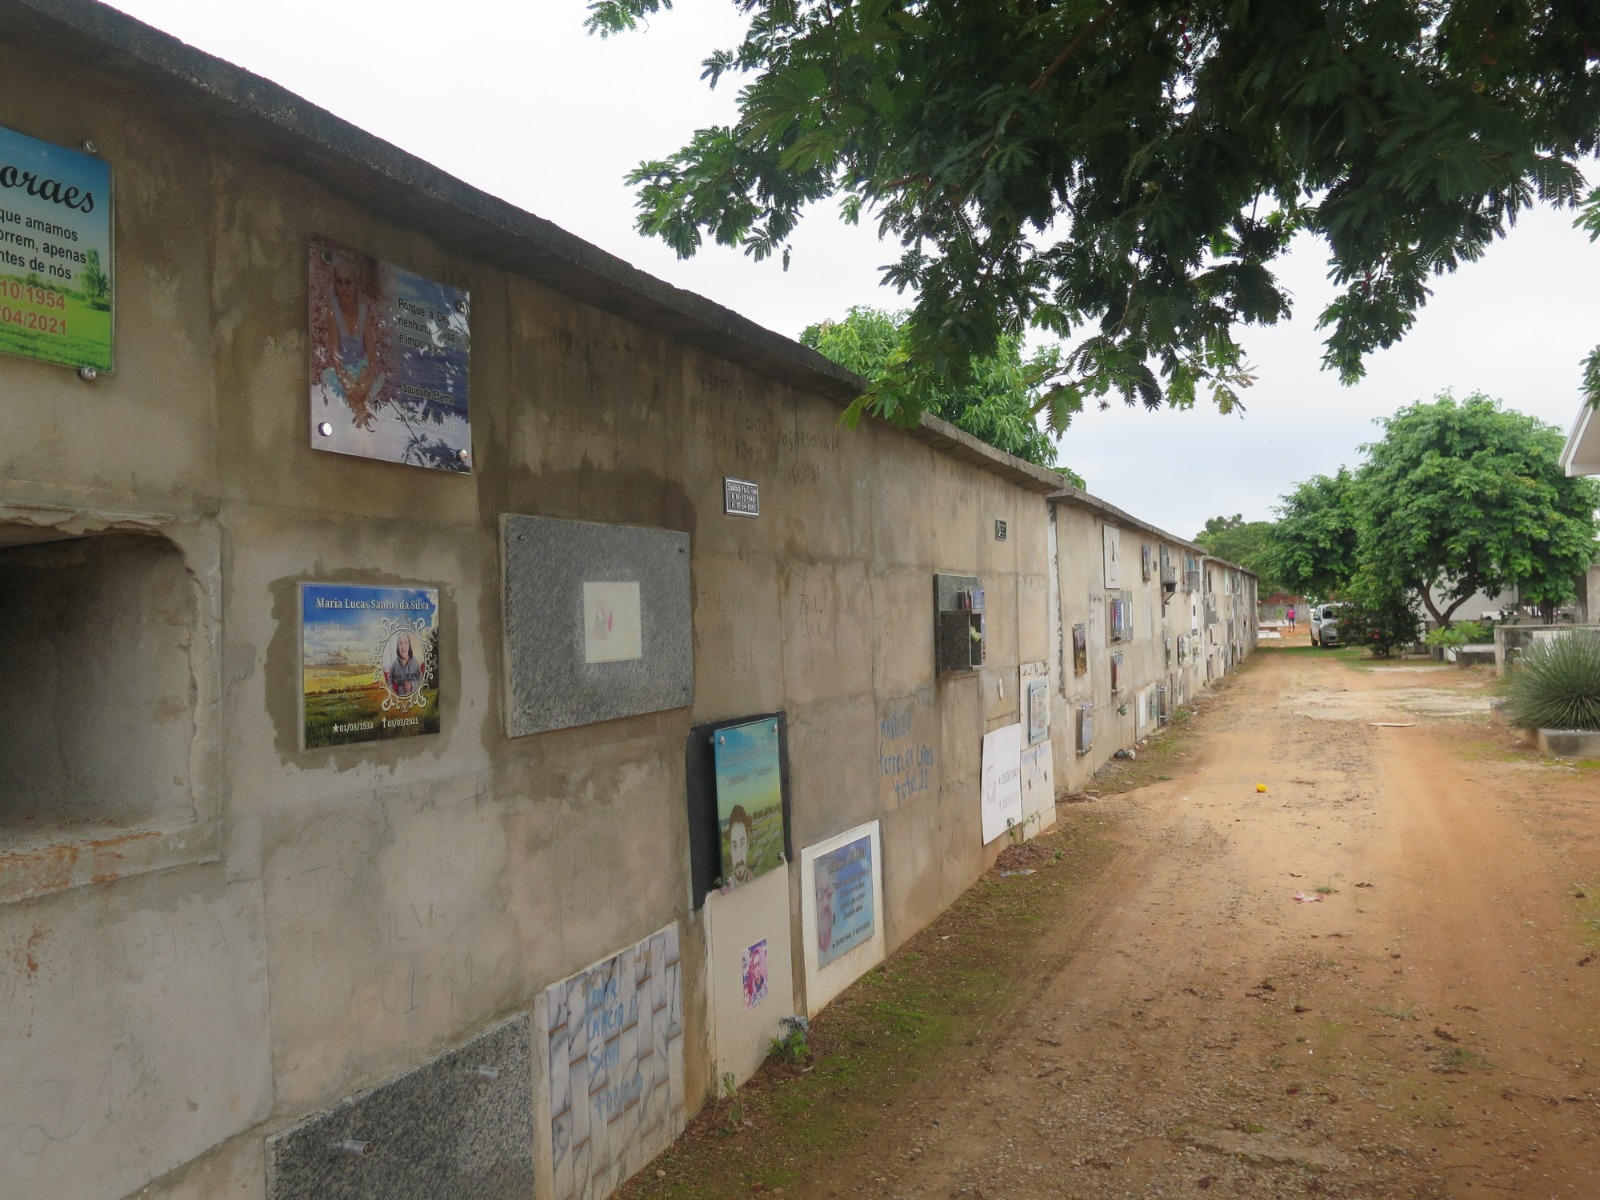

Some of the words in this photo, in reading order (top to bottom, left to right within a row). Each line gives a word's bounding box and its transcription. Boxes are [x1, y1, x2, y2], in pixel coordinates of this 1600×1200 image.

[25, 216, 78, 242] amamos
[42, 242, 87, 264] apenas
[29, 256, 45, 273] de
[49, 263, 72, 280] nós
[398, 297, 425, 318] Porque
[428, 309, 435, 319] a
[398, 331, 405, 344] é
[402, 381, 432, 399] Saudade
[433, 390, 455, 404] Eterna
[316, 597, 343, 609] Maria
[344, 598, 370, 610] Lucas
[370, 599, 398, 611] Santos
[399, 600, 409, 611] da
[410, 600, 430, 611] Silva
[339, 721, 374, 733] 01/03/1933
[387, 717, 419, 729] 03/03/2021
